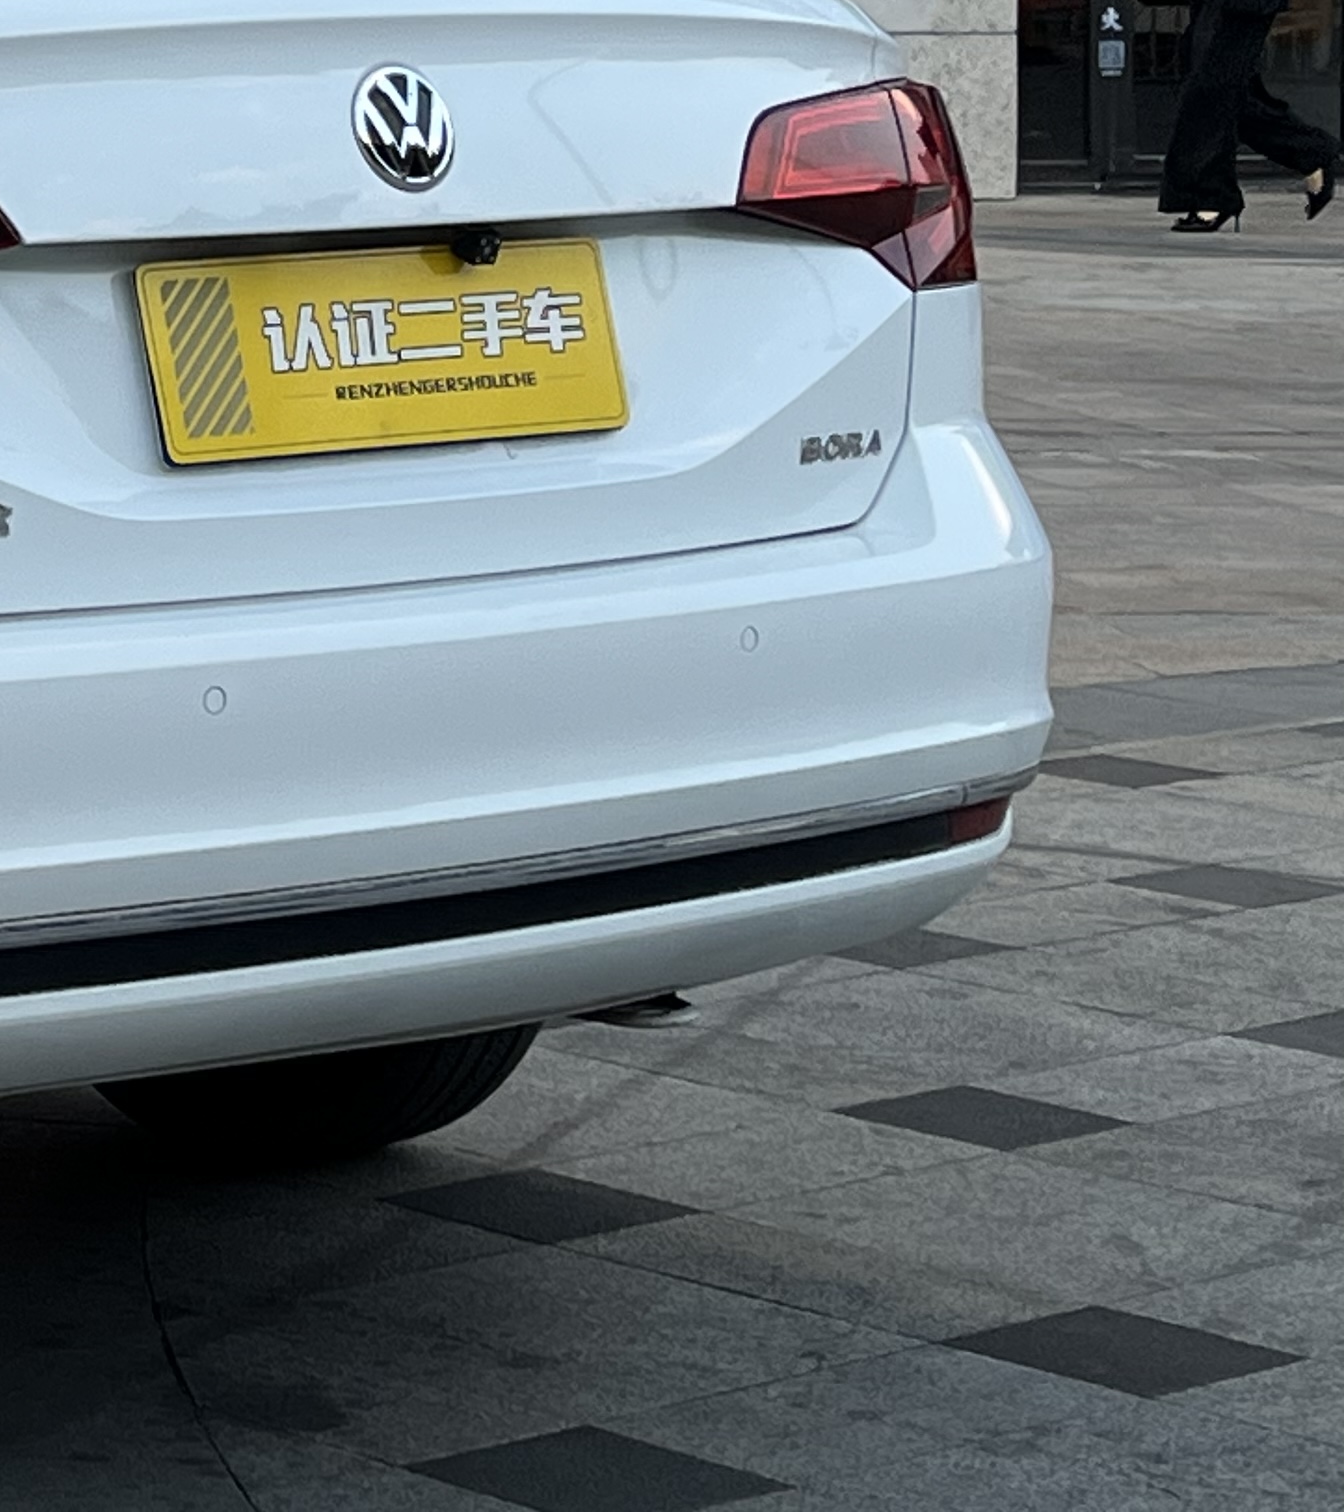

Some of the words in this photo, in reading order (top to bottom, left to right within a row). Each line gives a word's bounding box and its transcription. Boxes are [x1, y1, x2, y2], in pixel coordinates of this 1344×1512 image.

[262, 287, 586, 374] 认证二手车
[335, 371, 538, 401] RENZHENGERSHOUCHE
[800, 429, 882, 465] BORA
